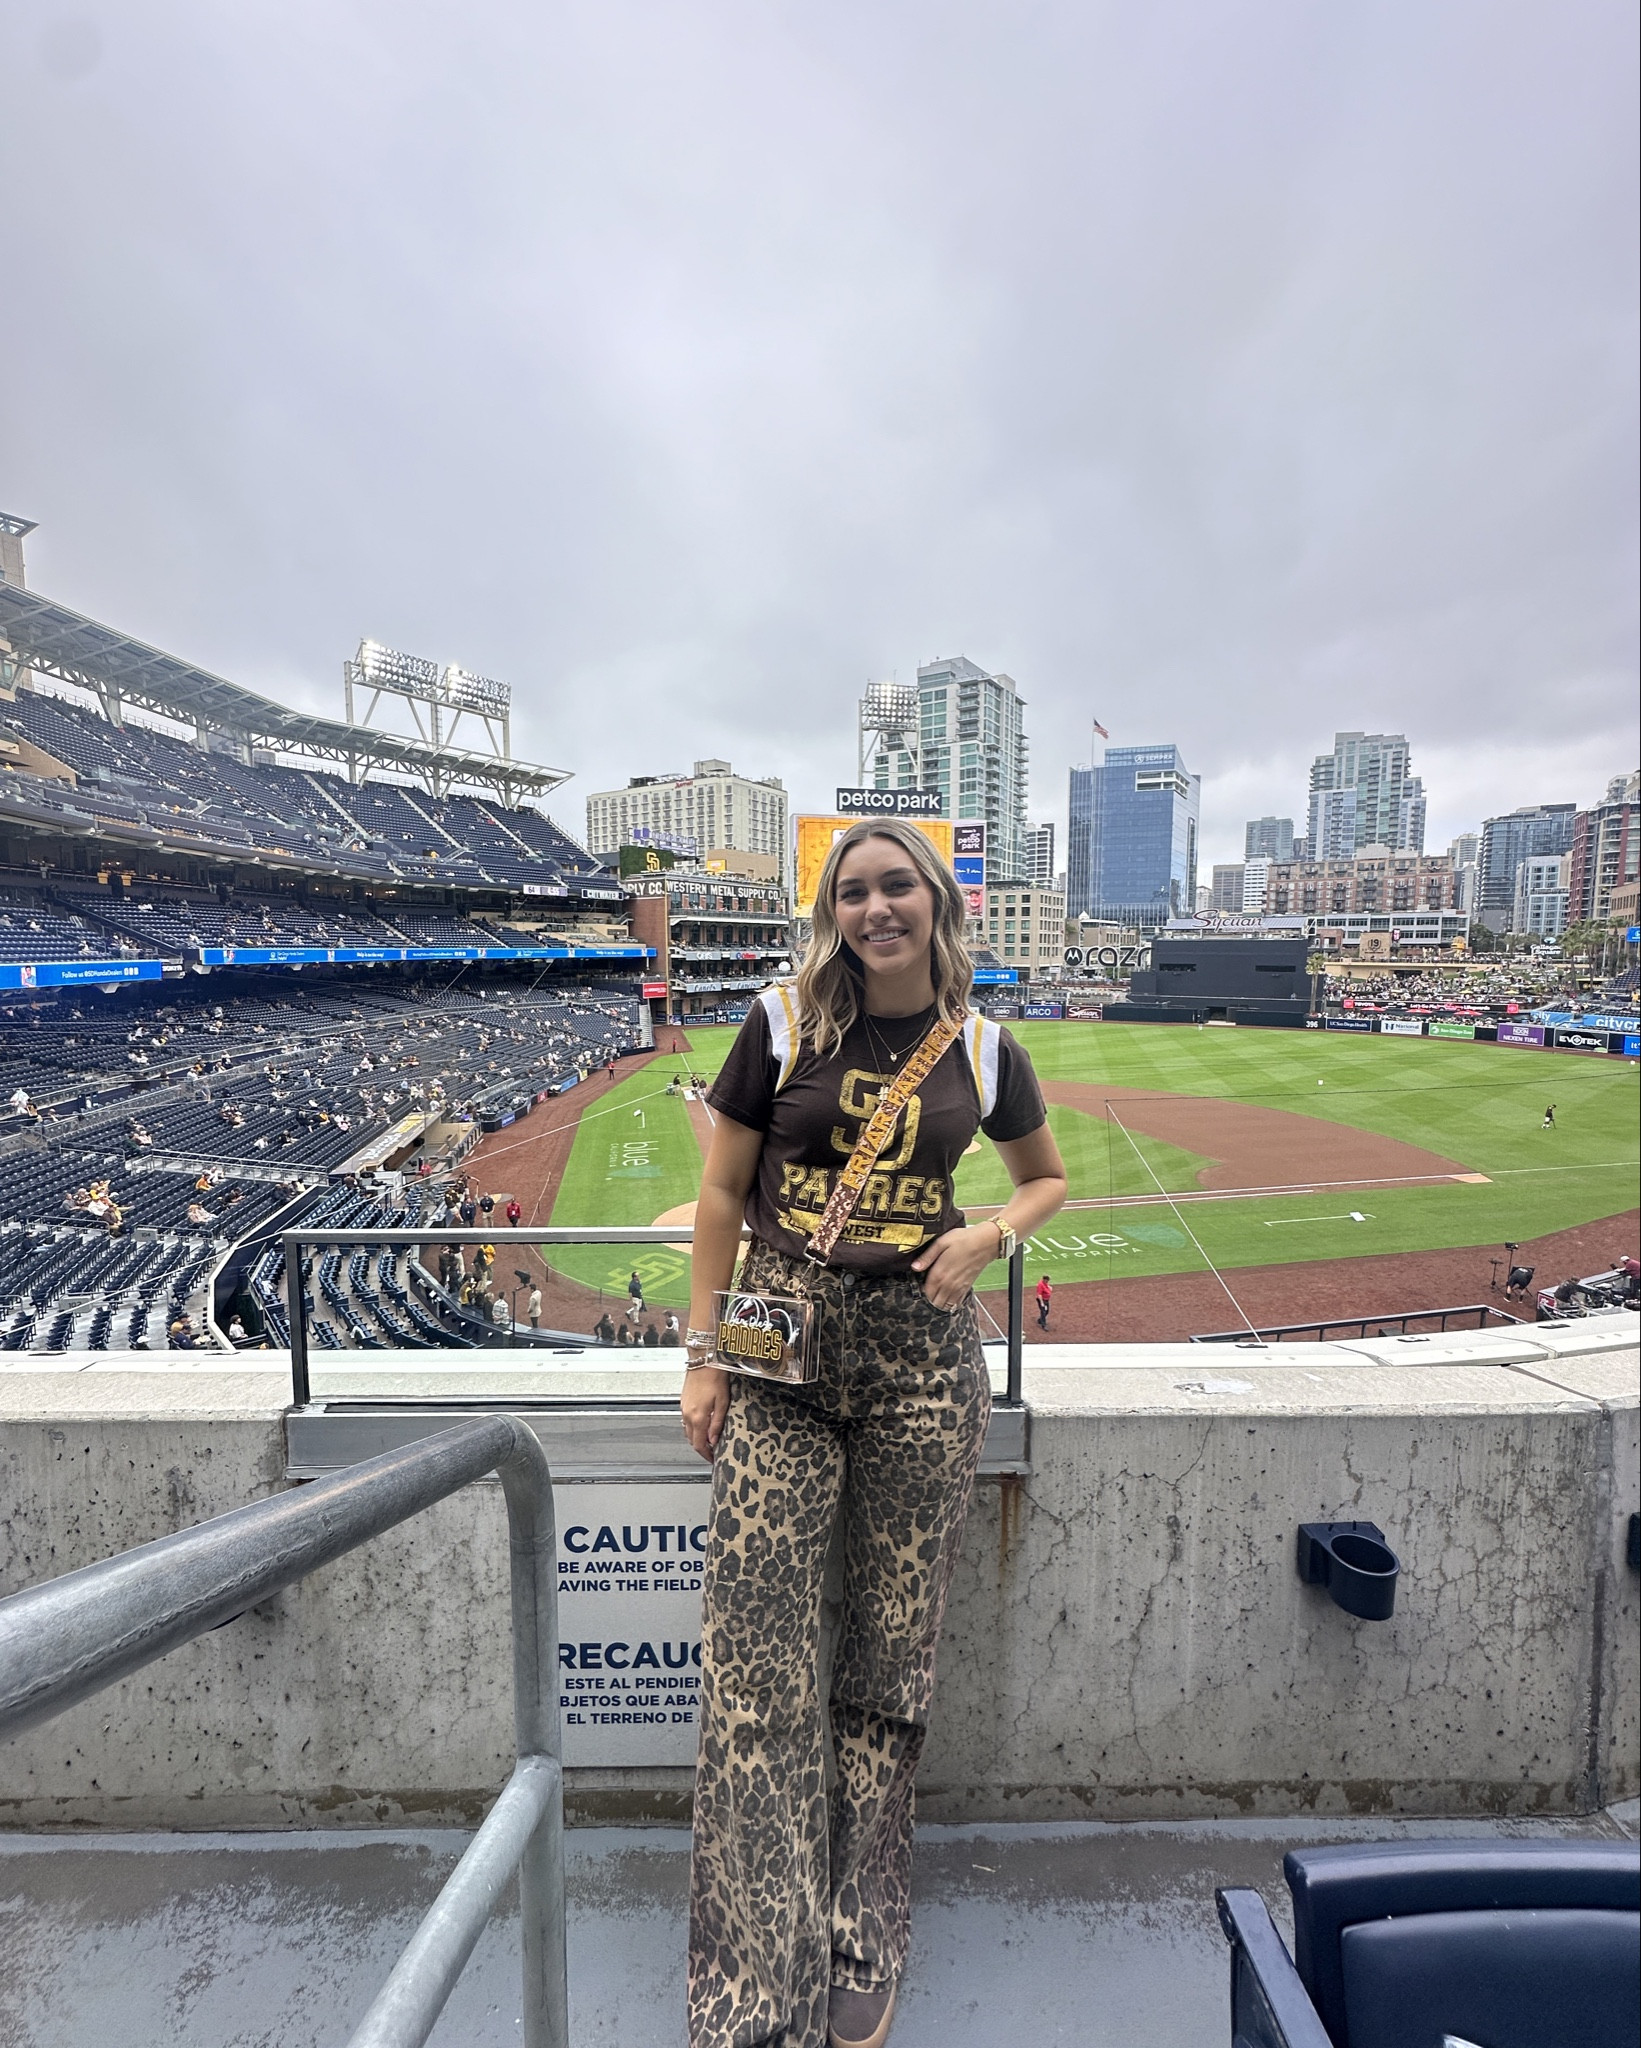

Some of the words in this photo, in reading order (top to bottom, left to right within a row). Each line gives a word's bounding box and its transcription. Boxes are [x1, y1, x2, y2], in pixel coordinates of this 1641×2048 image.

[838, 790, 895, 810] petco
[897, 793, 941, 811] park
[648, 881, 665, 895] CO.
[666, 880, 708, 895] WESTERN
[710, 883, 737, 897] METAL
[738, 886, 766, 900] SUPPLY
[768, 889, 782, 901] CO.
[1192, 909, 1263, 933] Sycuan
[1085, 946, 1152, 967] razr
[61, 971, 78, 979] Follow
[1026, 1008, 1051, 1016] ARCO
[1068, 1006, 1098, 1020] Sycuan
[1306, 1020, 1318, 1028] 396
[1503, 1034, 1525, 1043] NEXEN
[1525, 1036, 1538, 1044] TIRE
[1559, 1034, 1602, 1046] EVOTEK
[622, 1140, 660, 1167] blue
[842, 1111, 895, 1190] FRIAR
[778, 1160, 948, 1223] PARES
[717, 1321, 783, 1361] PADRES
[558, 1561, 580, 1574] BE
[584, 1561, 647, 1573] AWARE
[651, 1561, 675, 1572] OF
[616, 1579, 649, 1591] THE
[654, 1579, 701, 1591] FIELD
[565, 1678, 605, 1689] ESTE
[610, 1678, 631, 1689] AL
[625, 1695, 660, 1708] QUE
[664, 1695, 701, 1706] ABA
[567, 1713, 586, 1725] EL
[590, 1712, 667, 1724] TERRENO
[671, 1712, 693, 1723] DE
